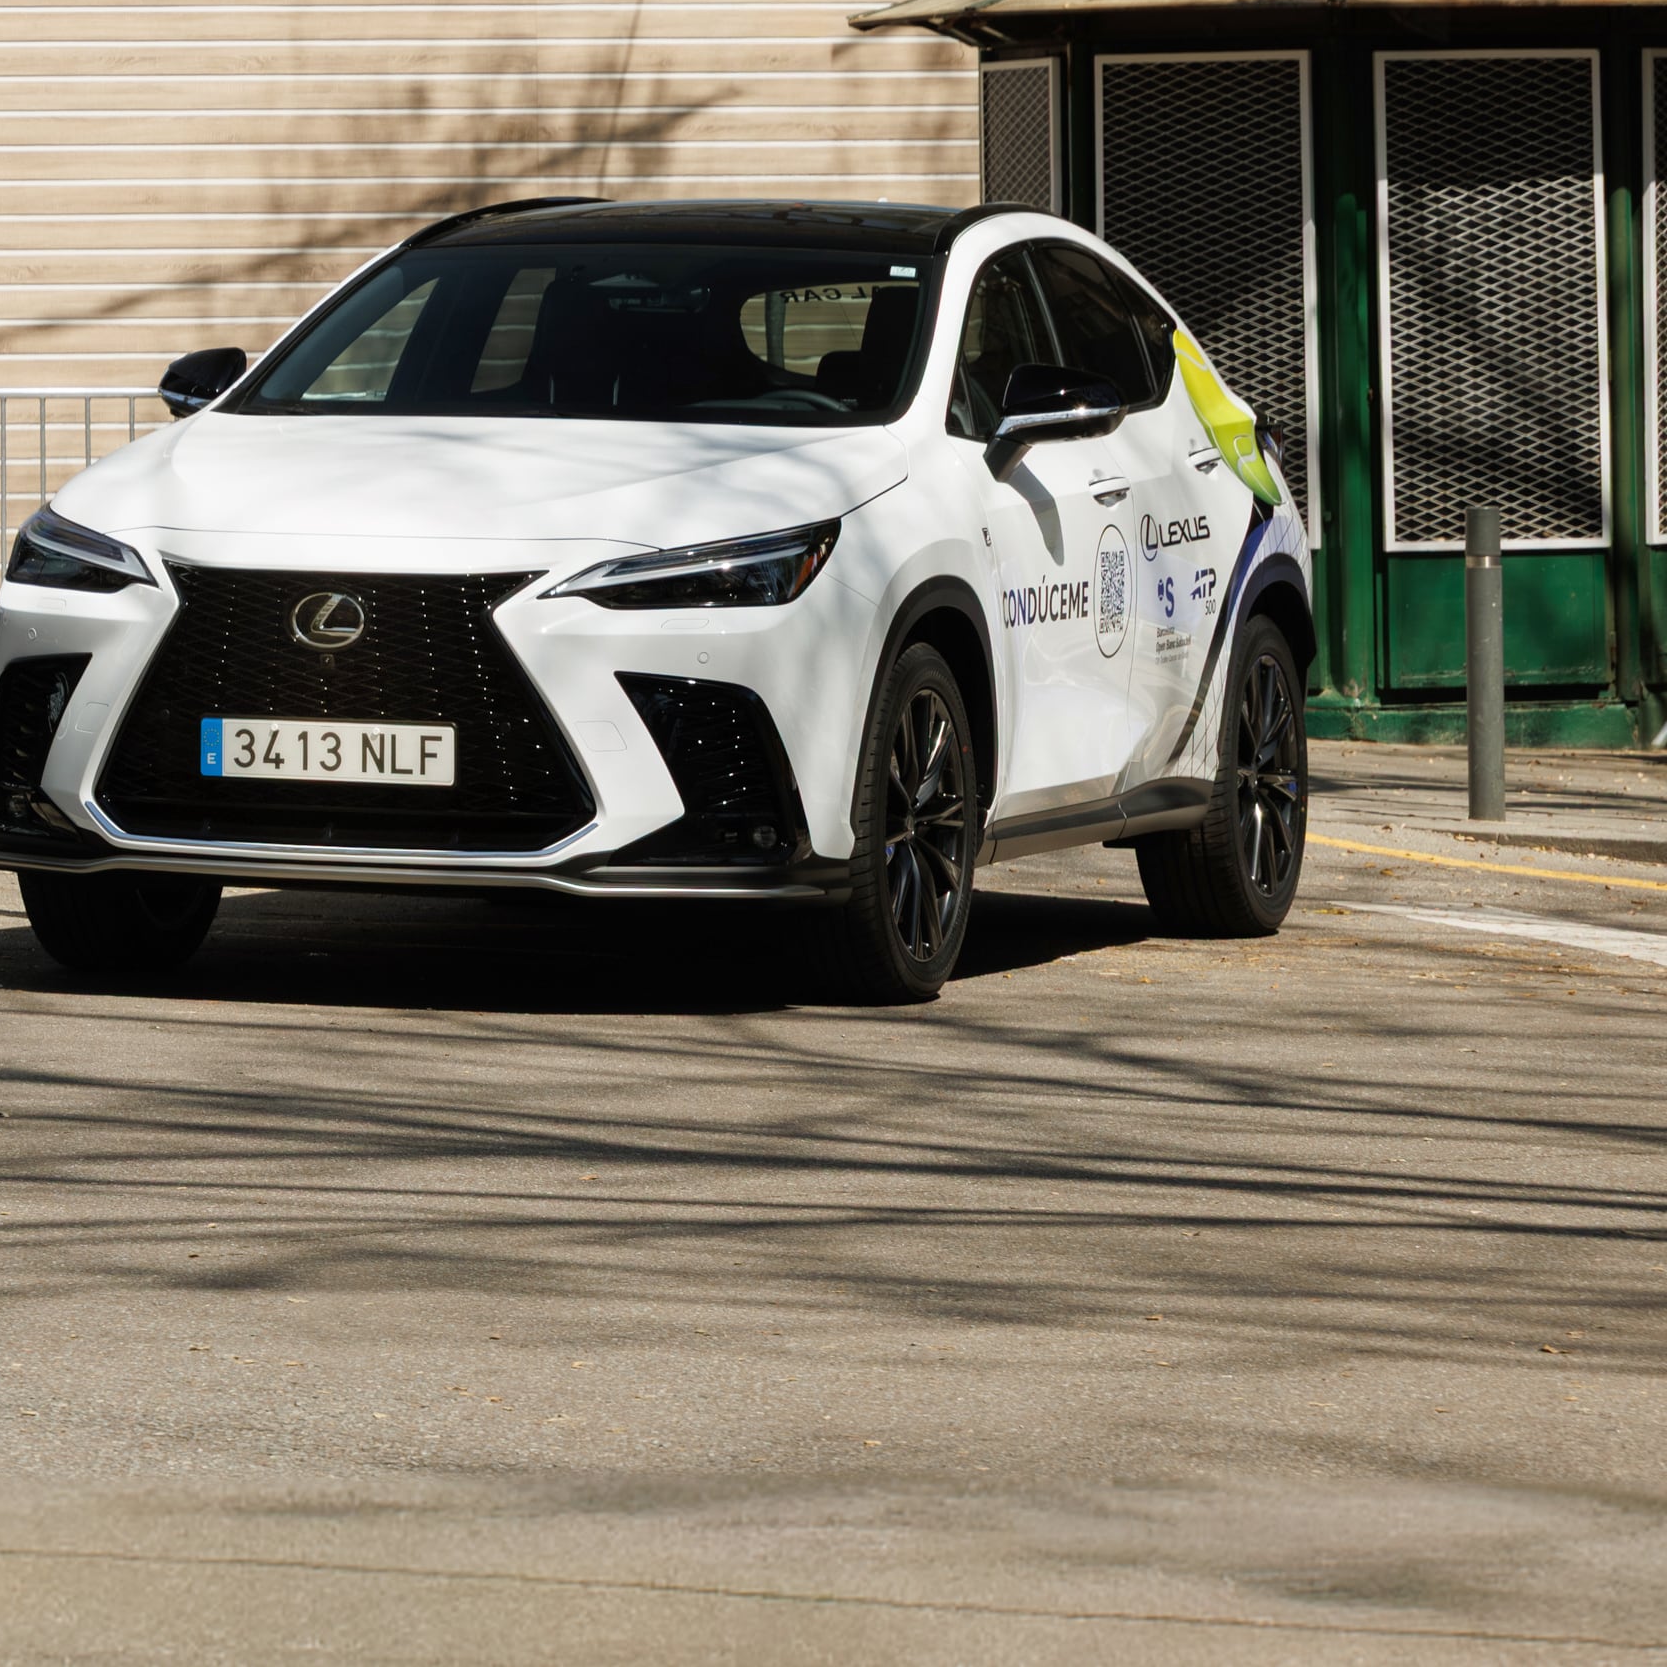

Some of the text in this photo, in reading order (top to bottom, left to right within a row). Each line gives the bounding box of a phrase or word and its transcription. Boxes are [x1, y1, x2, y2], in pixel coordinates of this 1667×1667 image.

[1159, 515, 1210, 547] LEXUS
[1190, 567, 1217, 600] ATP
[1002, 575, 1089, 629] CONDÚCEME
[1205, 599, 1216, 615] 500
[207, 728, 443, 775] E 3413 NLF
